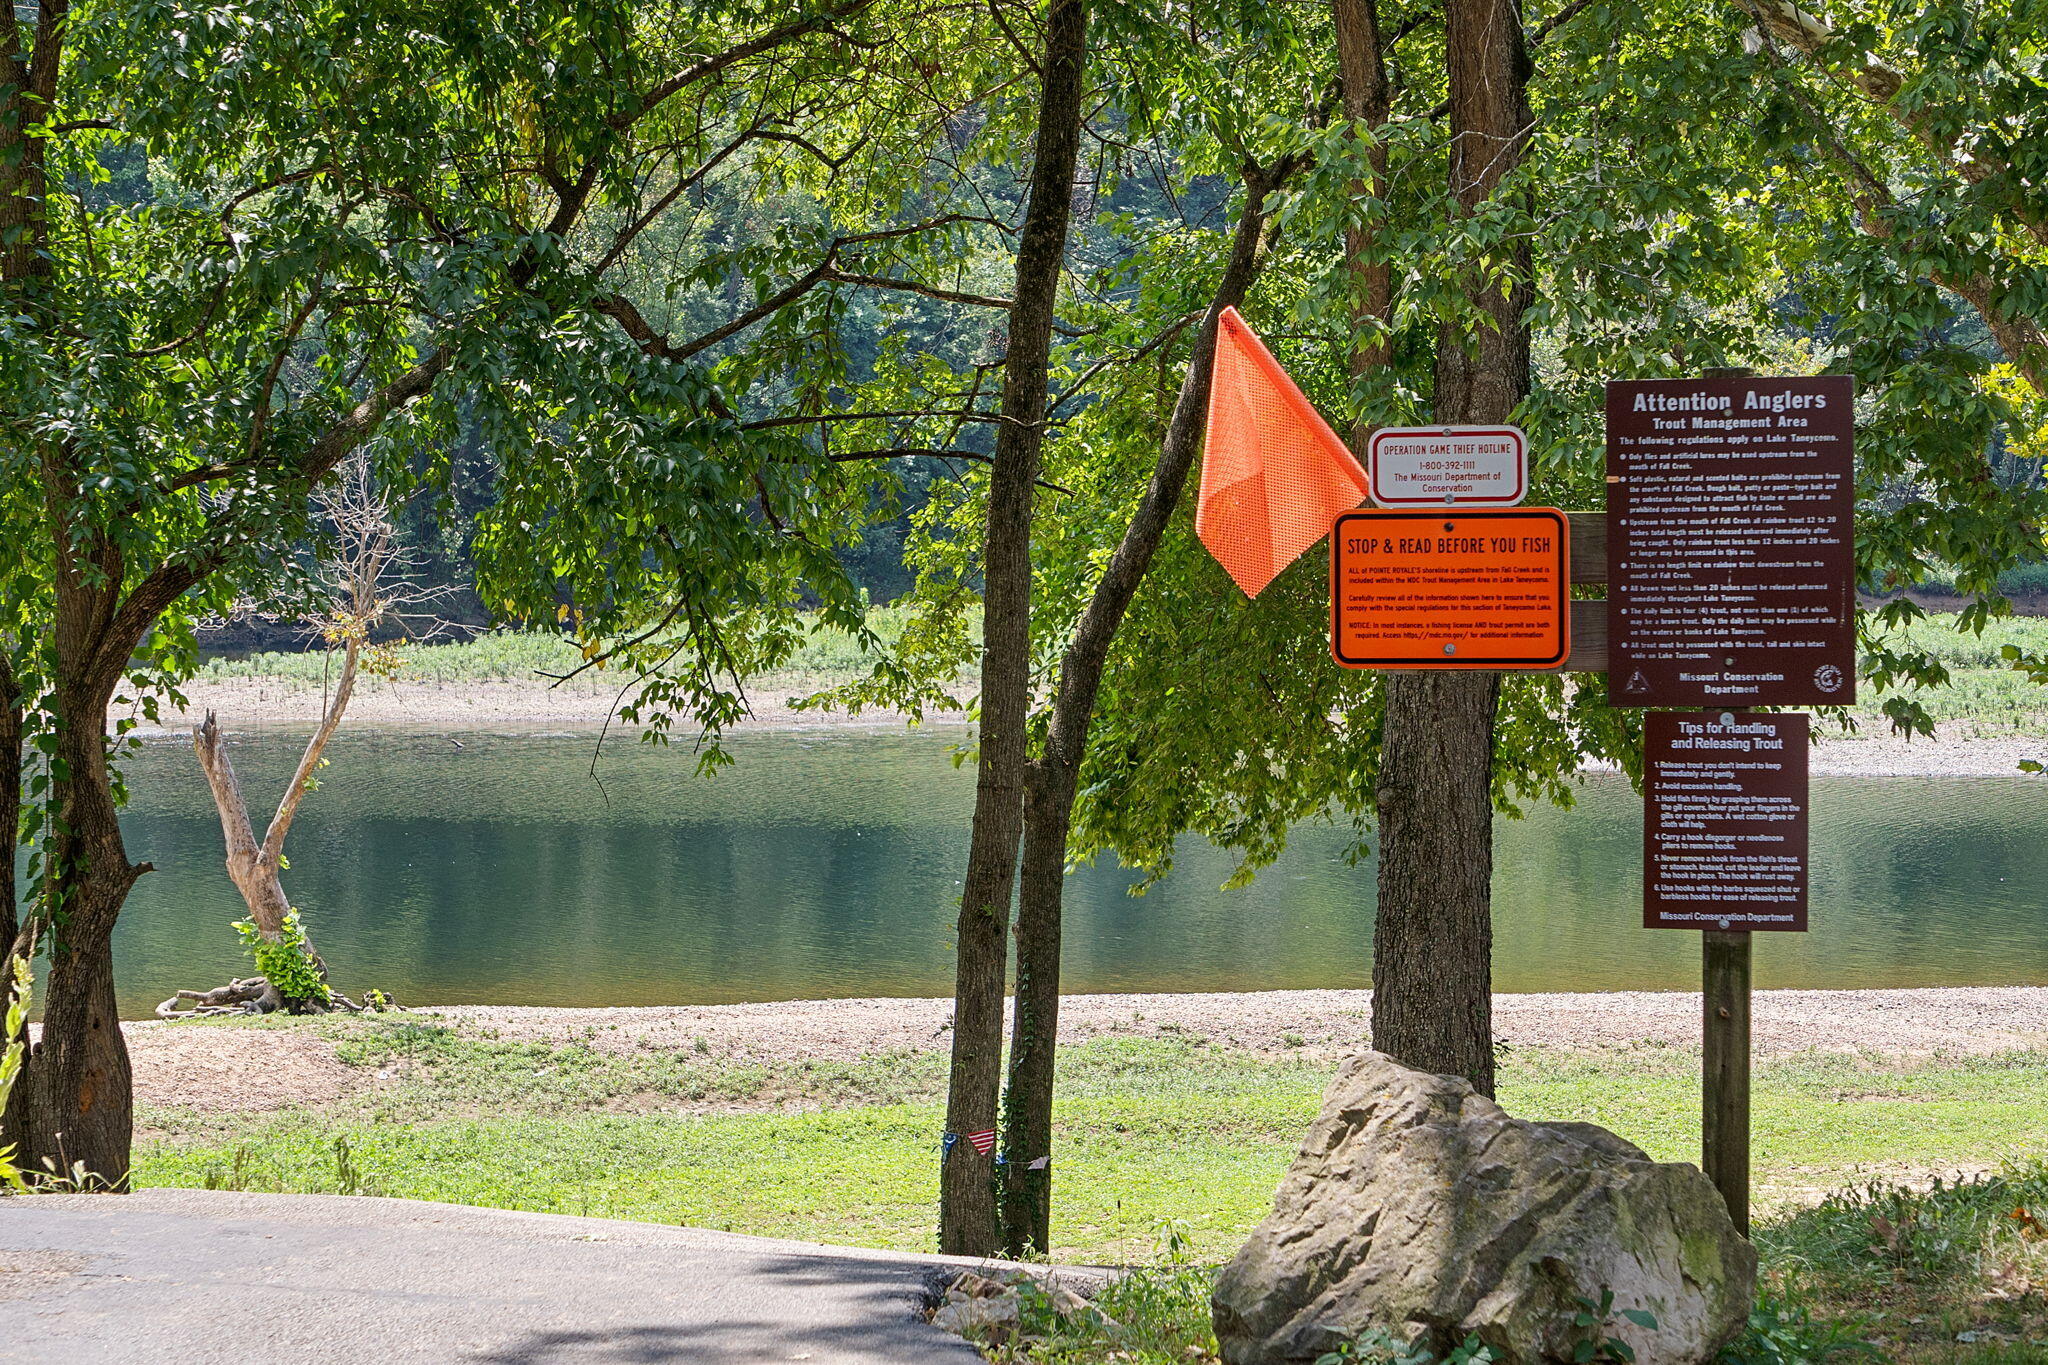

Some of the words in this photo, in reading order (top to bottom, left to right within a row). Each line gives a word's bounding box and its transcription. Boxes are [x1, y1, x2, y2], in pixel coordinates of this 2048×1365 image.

[1634, 392, 1730, 412] Attention
[1744, 391, 1826, 415] Anglers
[1654, 417, 1685, 430] Trout
[1691, 416, 1771, 432] Management
[1777, 416, 1807, 428] Area
[1620, 437, 1633, 445] The
[1638, 436, 1674, 447] following
[1677, 436, 1723, 446] regulations
[1727, 435, 1748, 445] apply
[1766, 435, 1786, 443] Lake
[1383, 444, 1426, 455] OPERATION
[1429, 444, 1450, 454] GAME
[1453, 444, 1474, 454] THIEF
[1478, 443, 1510, 454] HOTLINE
[1419, 461, 1475, 470] 1-800-392-1111
[1394, 473, 1407, 481] The
[1410, 473, 1441, 481] Missouri
[1444, 472, 1490, 483] Department
[1492, 472, 1500, 480] of
[1422, 484, 1472, 492] Conservation
[1348, 539, 1377, 554] STOP
[1383, 539, 1393, 554] &
[1399, 538, 1431, 554] READ
[1437, 538, 1484, 553] BEFORE
[1491, 538, 1516, 553] YOU
[1522, 538, 1550, 553] FISH
[1679, 672, 1718, 681] Missouri
[1723, 672, 1783, 681] Conservation
[1704, 685, 1758, 696] Department
[1680, 722, 1703, 737] Tips
[1706, 723, 1724, 734] for
[1726, 723, 1776, 737] Handling
[1671, 738, 1692, 749] and
[1694, 738, 1750, 752] Releasing
[1754, 738, 1783, 750] Trout
[1659, 912, 1693, 921] Missouri
[1693, 912, 1746, 921] Conservation
[1746, 913, 1794, 924] Department
